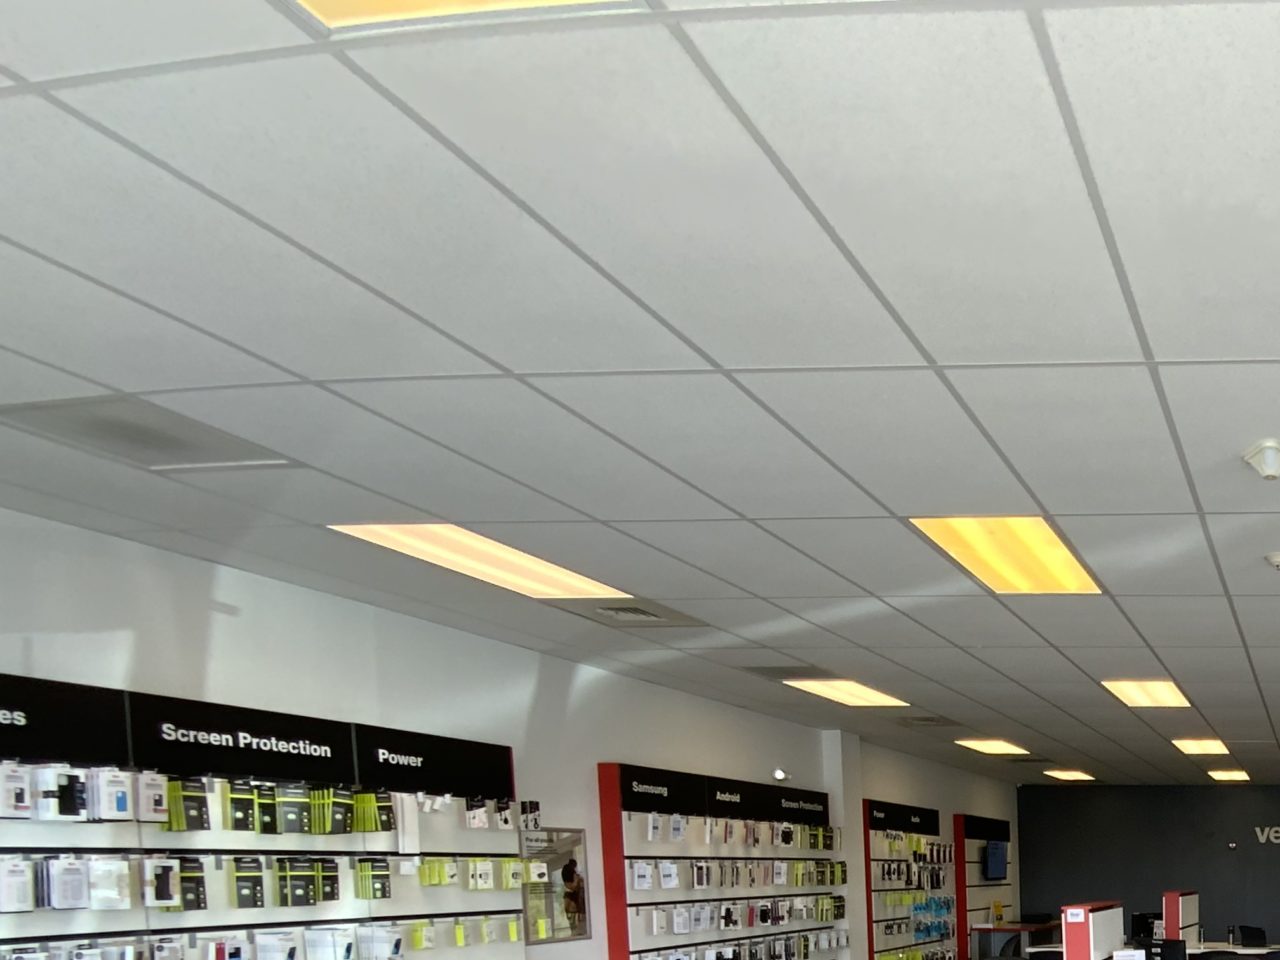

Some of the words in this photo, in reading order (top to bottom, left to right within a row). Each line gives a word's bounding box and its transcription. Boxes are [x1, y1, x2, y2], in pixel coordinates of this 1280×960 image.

[161, 723, 233, 747] Screen
[238, 732, 332, 758] Protection
[378, 748, 424, 768] Power
[632, 781, 668, 797] Samsung
[716, 791, 741, 803] Android
